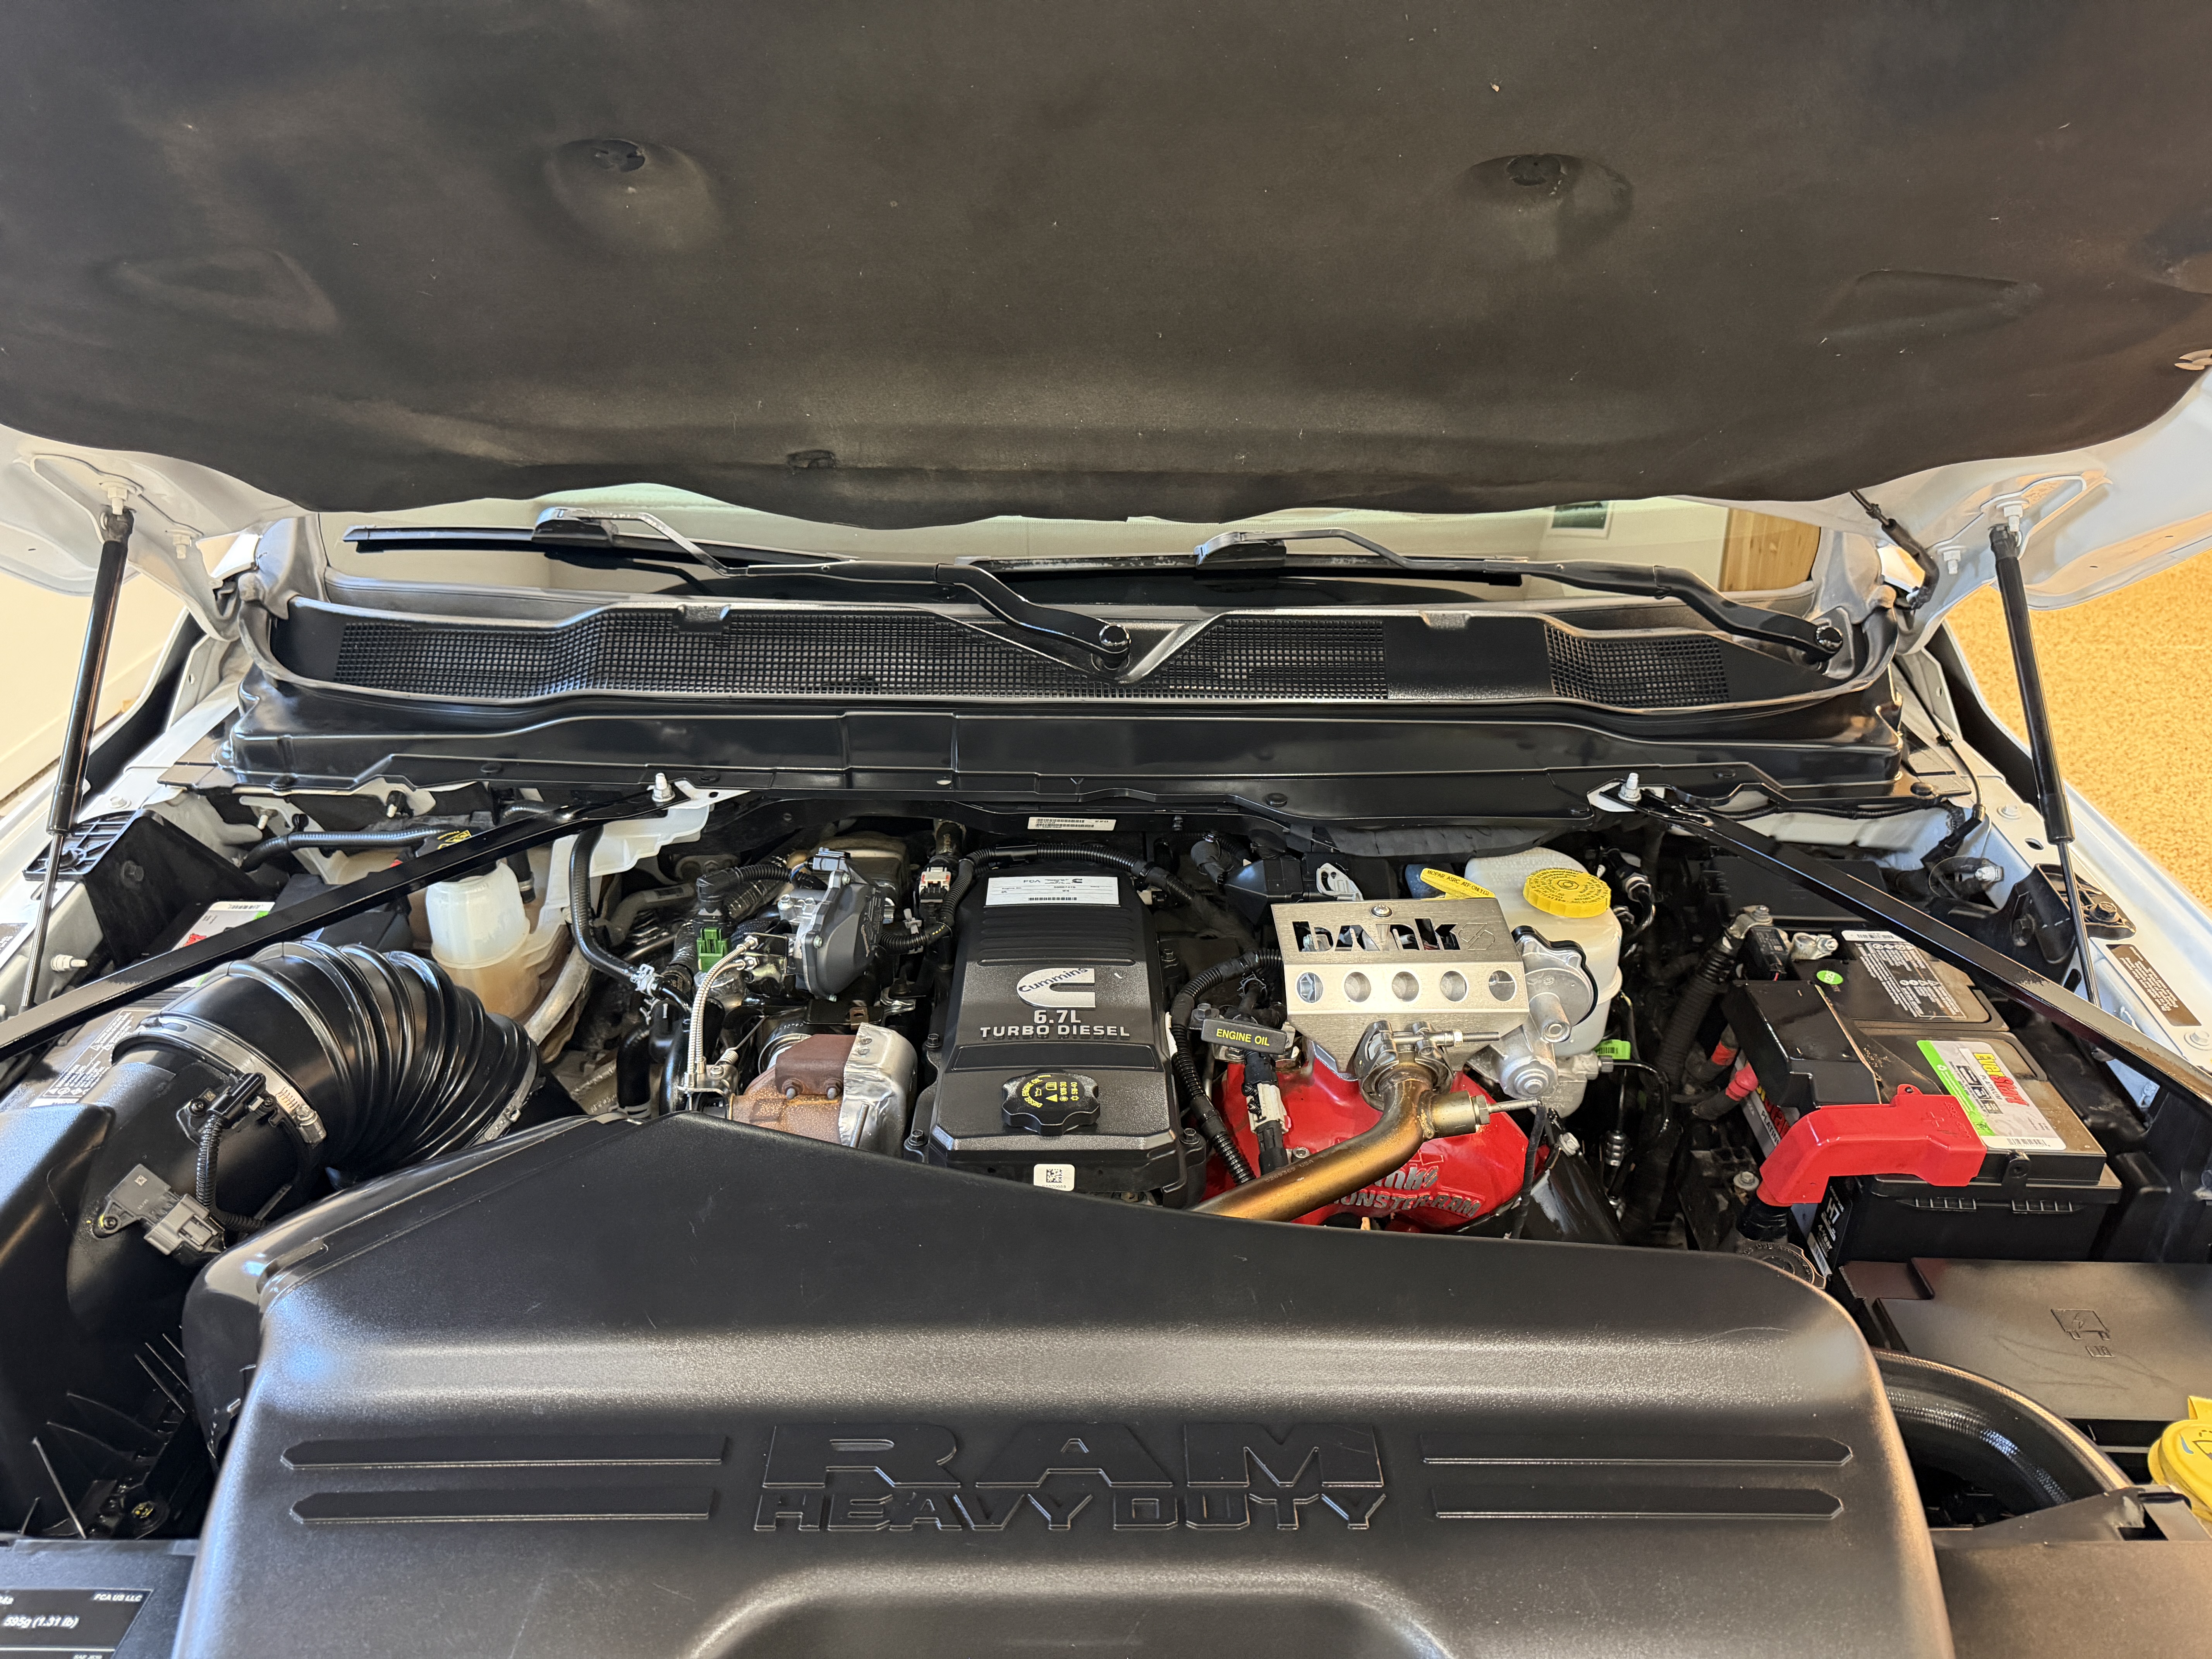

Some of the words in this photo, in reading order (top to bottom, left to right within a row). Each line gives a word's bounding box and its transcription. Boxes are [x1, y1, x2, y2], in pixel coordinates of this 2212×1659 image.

[1427, 870, 1445, 878] MOPAR
[1018, 968, 1088, 993] Cummins
[1034, 1010, 1081, 1024] 6.7L
[981, 1025, 1049, 1038] TURBO
[1058, 1025, 1130, 1038] DIESEL
[1216, 1028, 1252, 1044] ENGINE
[1255, 1033, 1270, 1046] OIL
[1973, 1053, 2030, 1106] EverStart
[1022, 1082, 1034, 1096] ENGINE
[1060, 1082, 1068, 1095] 10W-30
[1979, 1075, 2002, 1100] PLATINUM
[1024, 1096, 1043, 1108] DIESEL
[763, 1422, 1384, 1487] RAM
[754, 1492, 1094, 1531] HEAVY
[1113, 1492, 1386, 1531] DUTY
[3, 1617, 32, 1629] 595g
